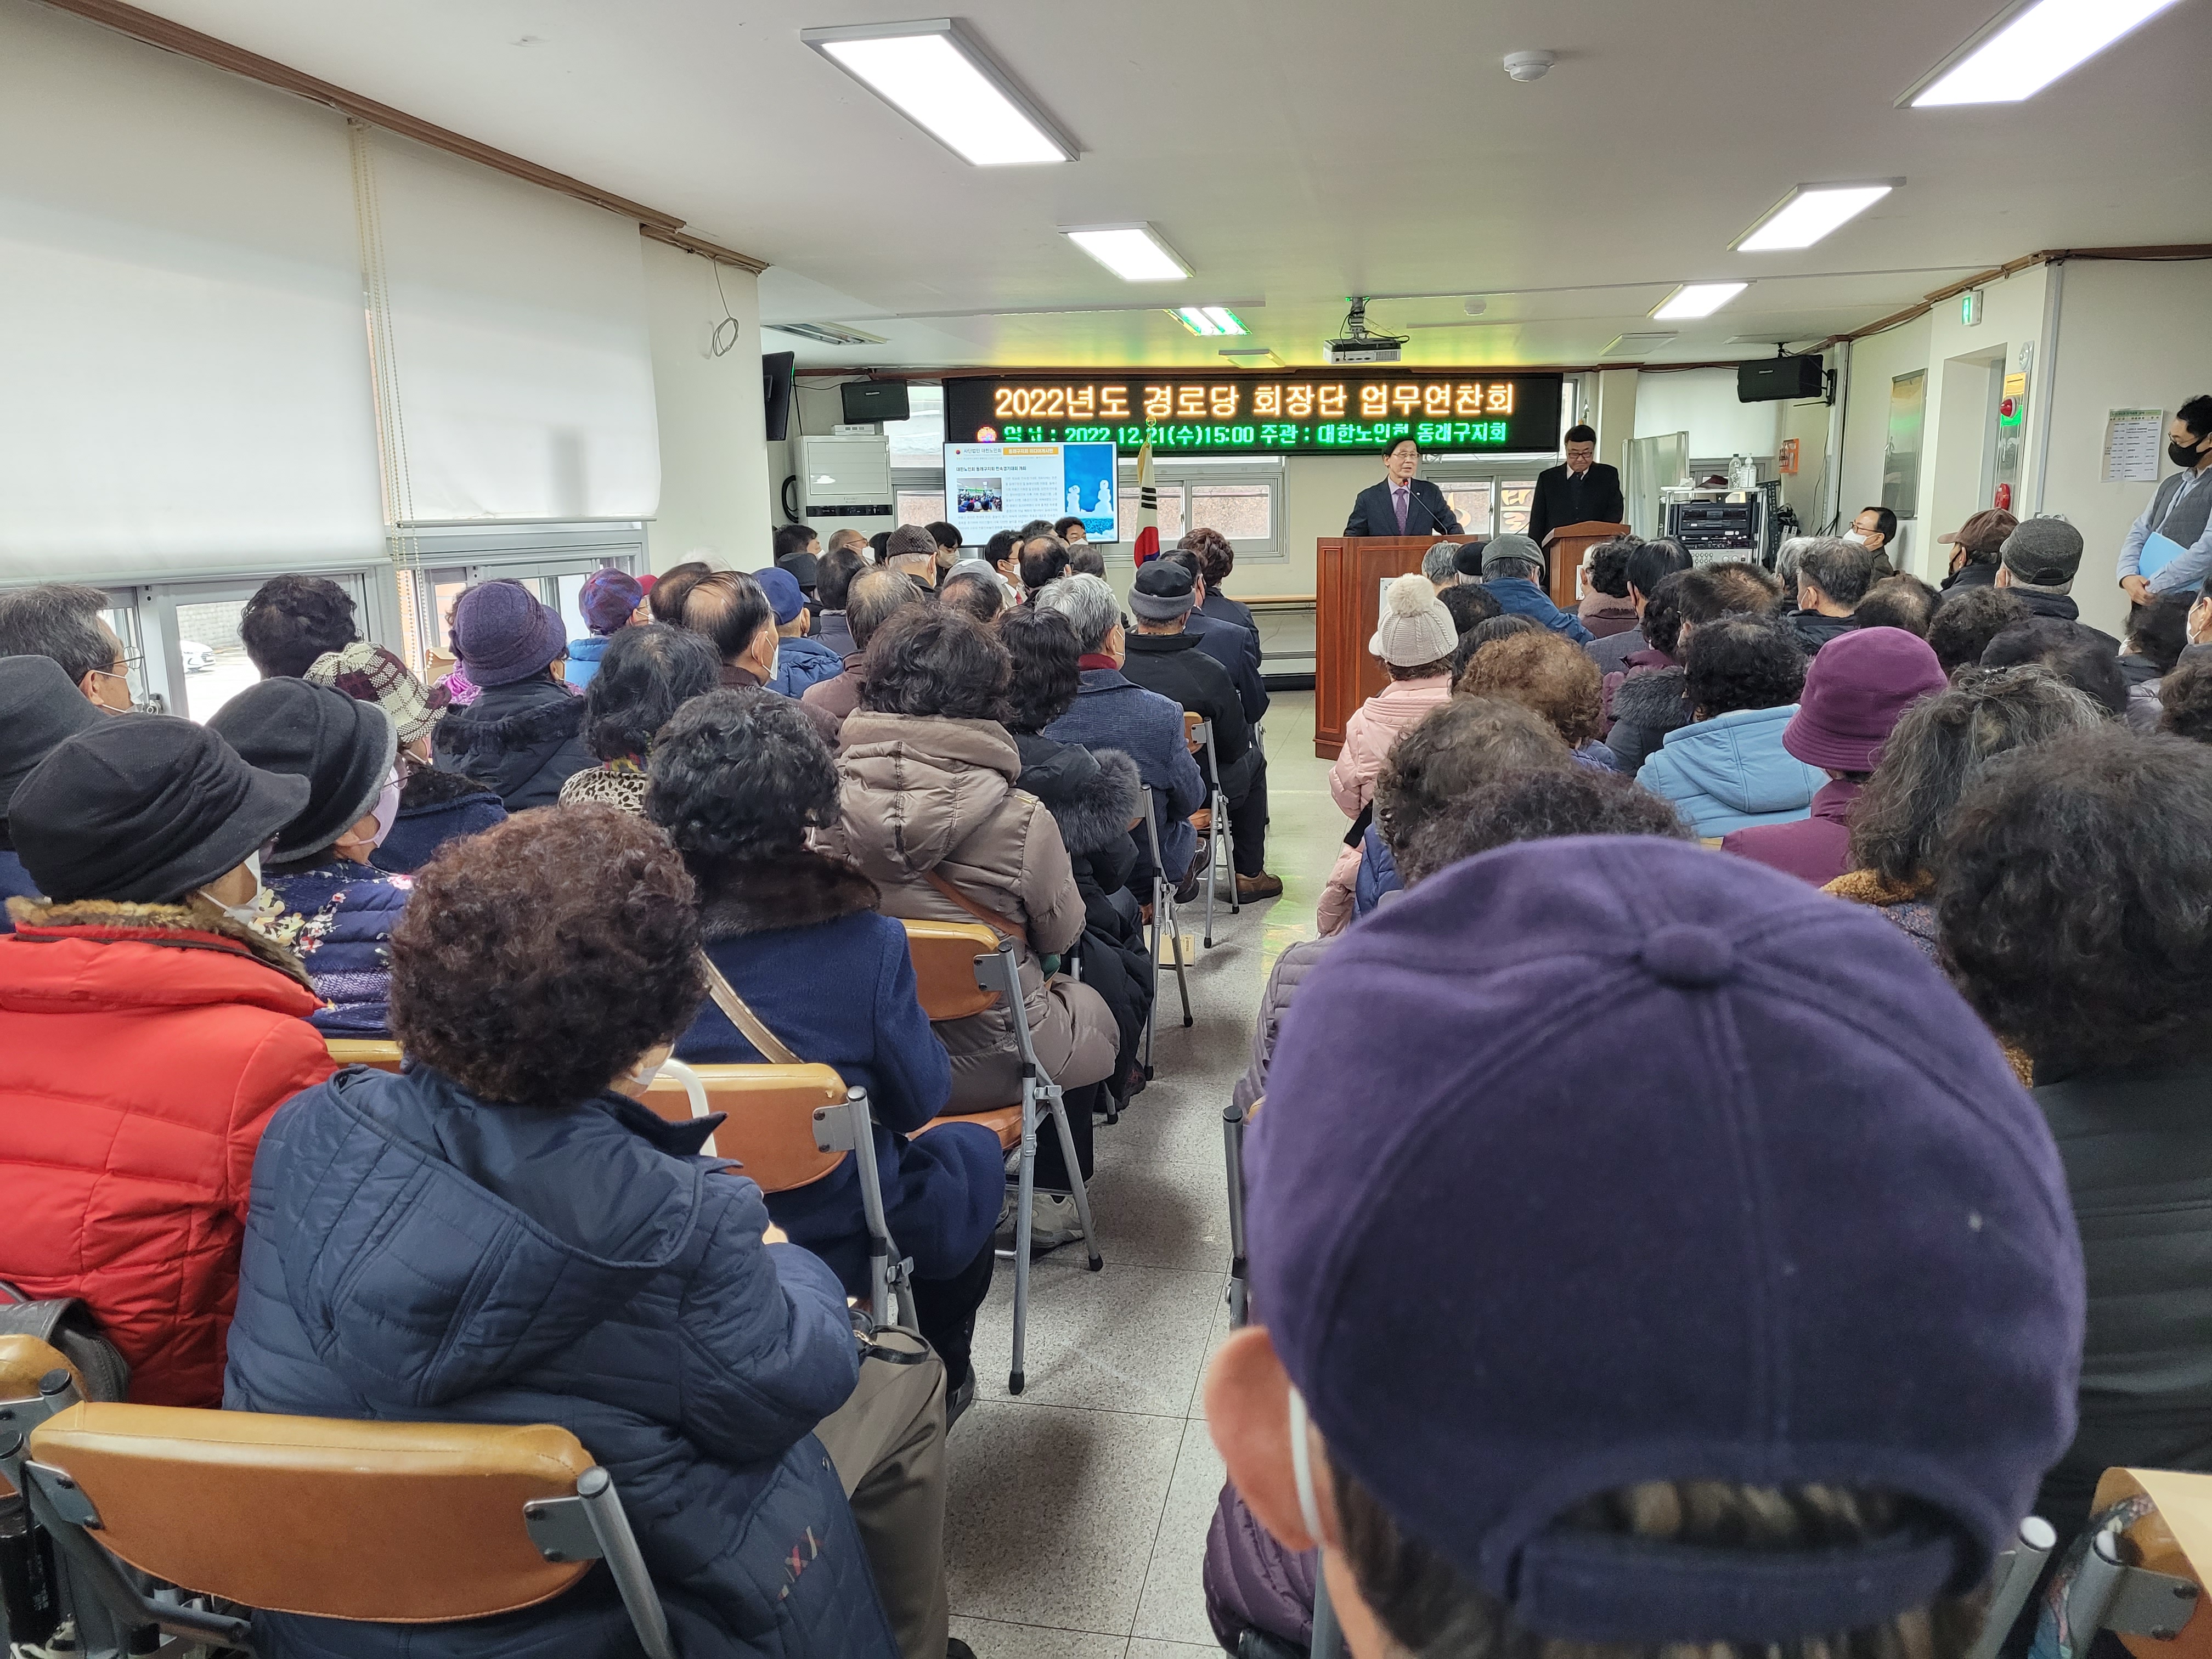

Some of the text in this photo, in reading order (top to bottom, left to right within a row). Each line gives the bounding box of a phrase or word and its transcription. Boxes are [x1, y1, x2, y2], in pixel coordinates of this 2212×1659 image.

[995, 383, 1513, 417] 2022년도 경로당 회장단 업무연찬회
[1260, 425, 1299, 445] 주관
[1416, 422, 1507, 444] 동래구지회
